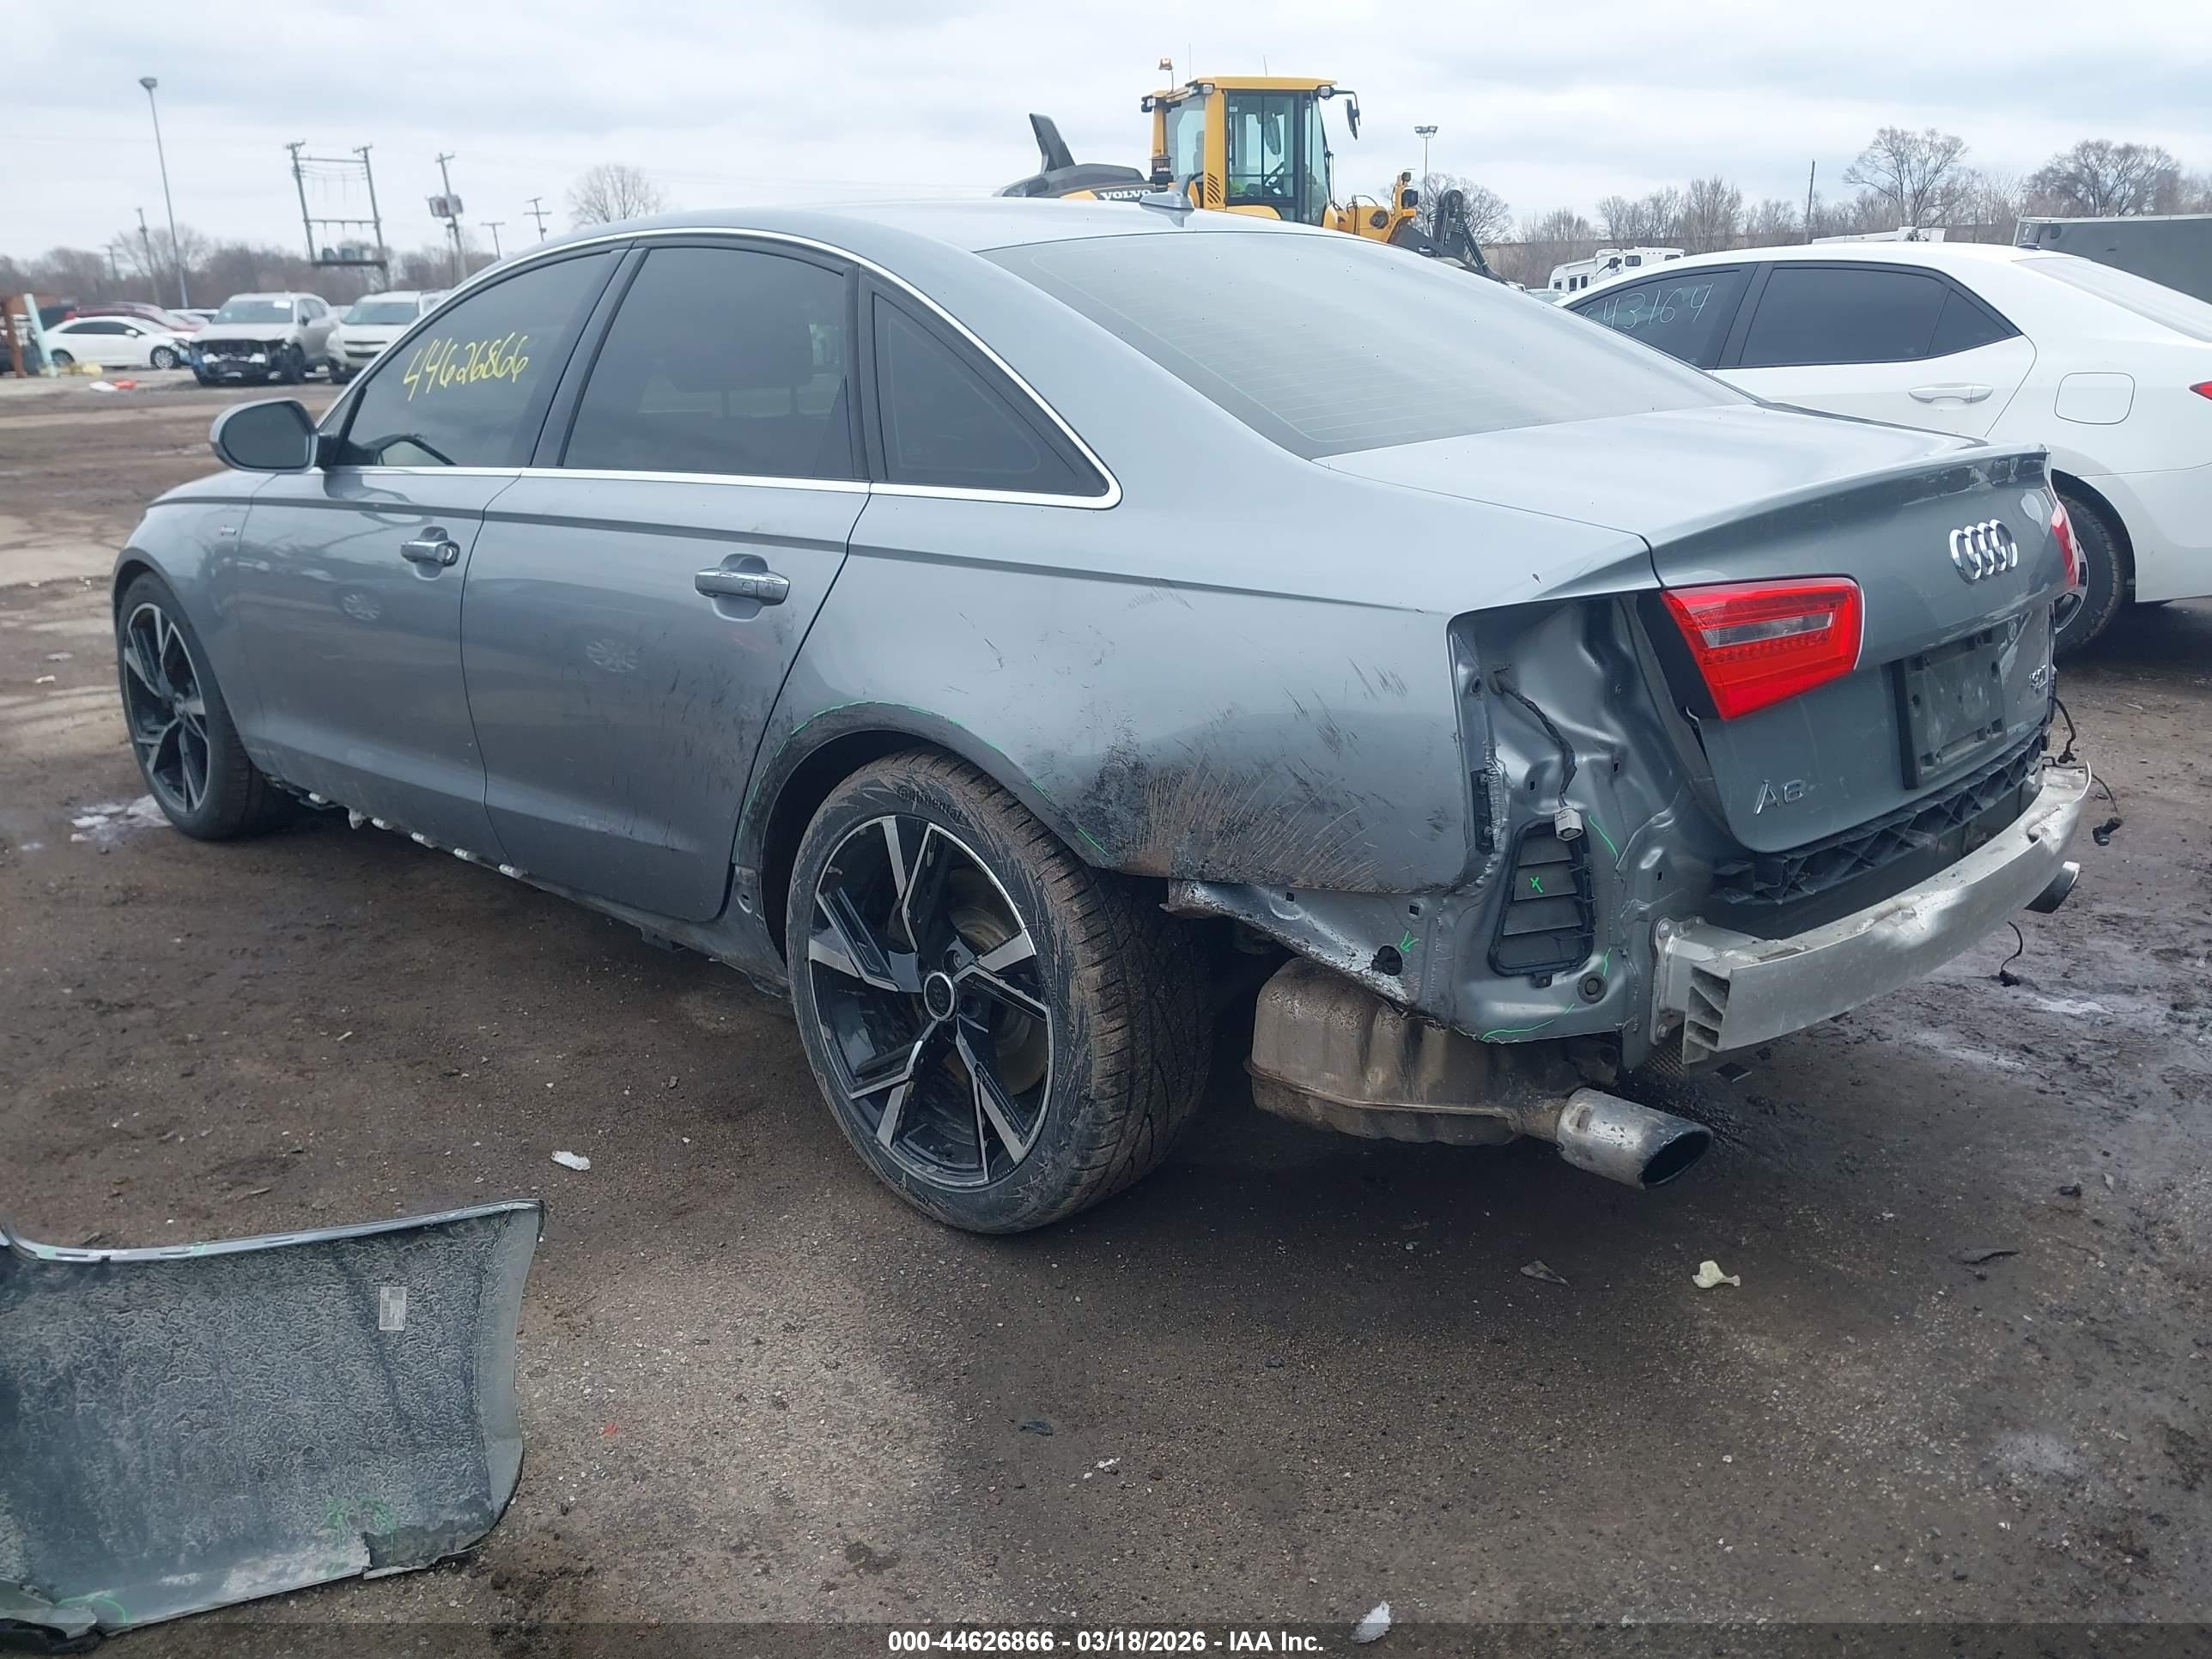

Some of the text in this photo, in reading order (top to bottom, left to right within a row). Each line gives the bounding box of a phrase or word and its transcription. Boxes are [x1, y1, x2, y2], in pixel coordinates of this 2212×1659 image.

[1099, 188, 1152, 201] VOLVO
[403, 331, 529, 402] 44626866
[1753, 778, 1805, 815] A6
